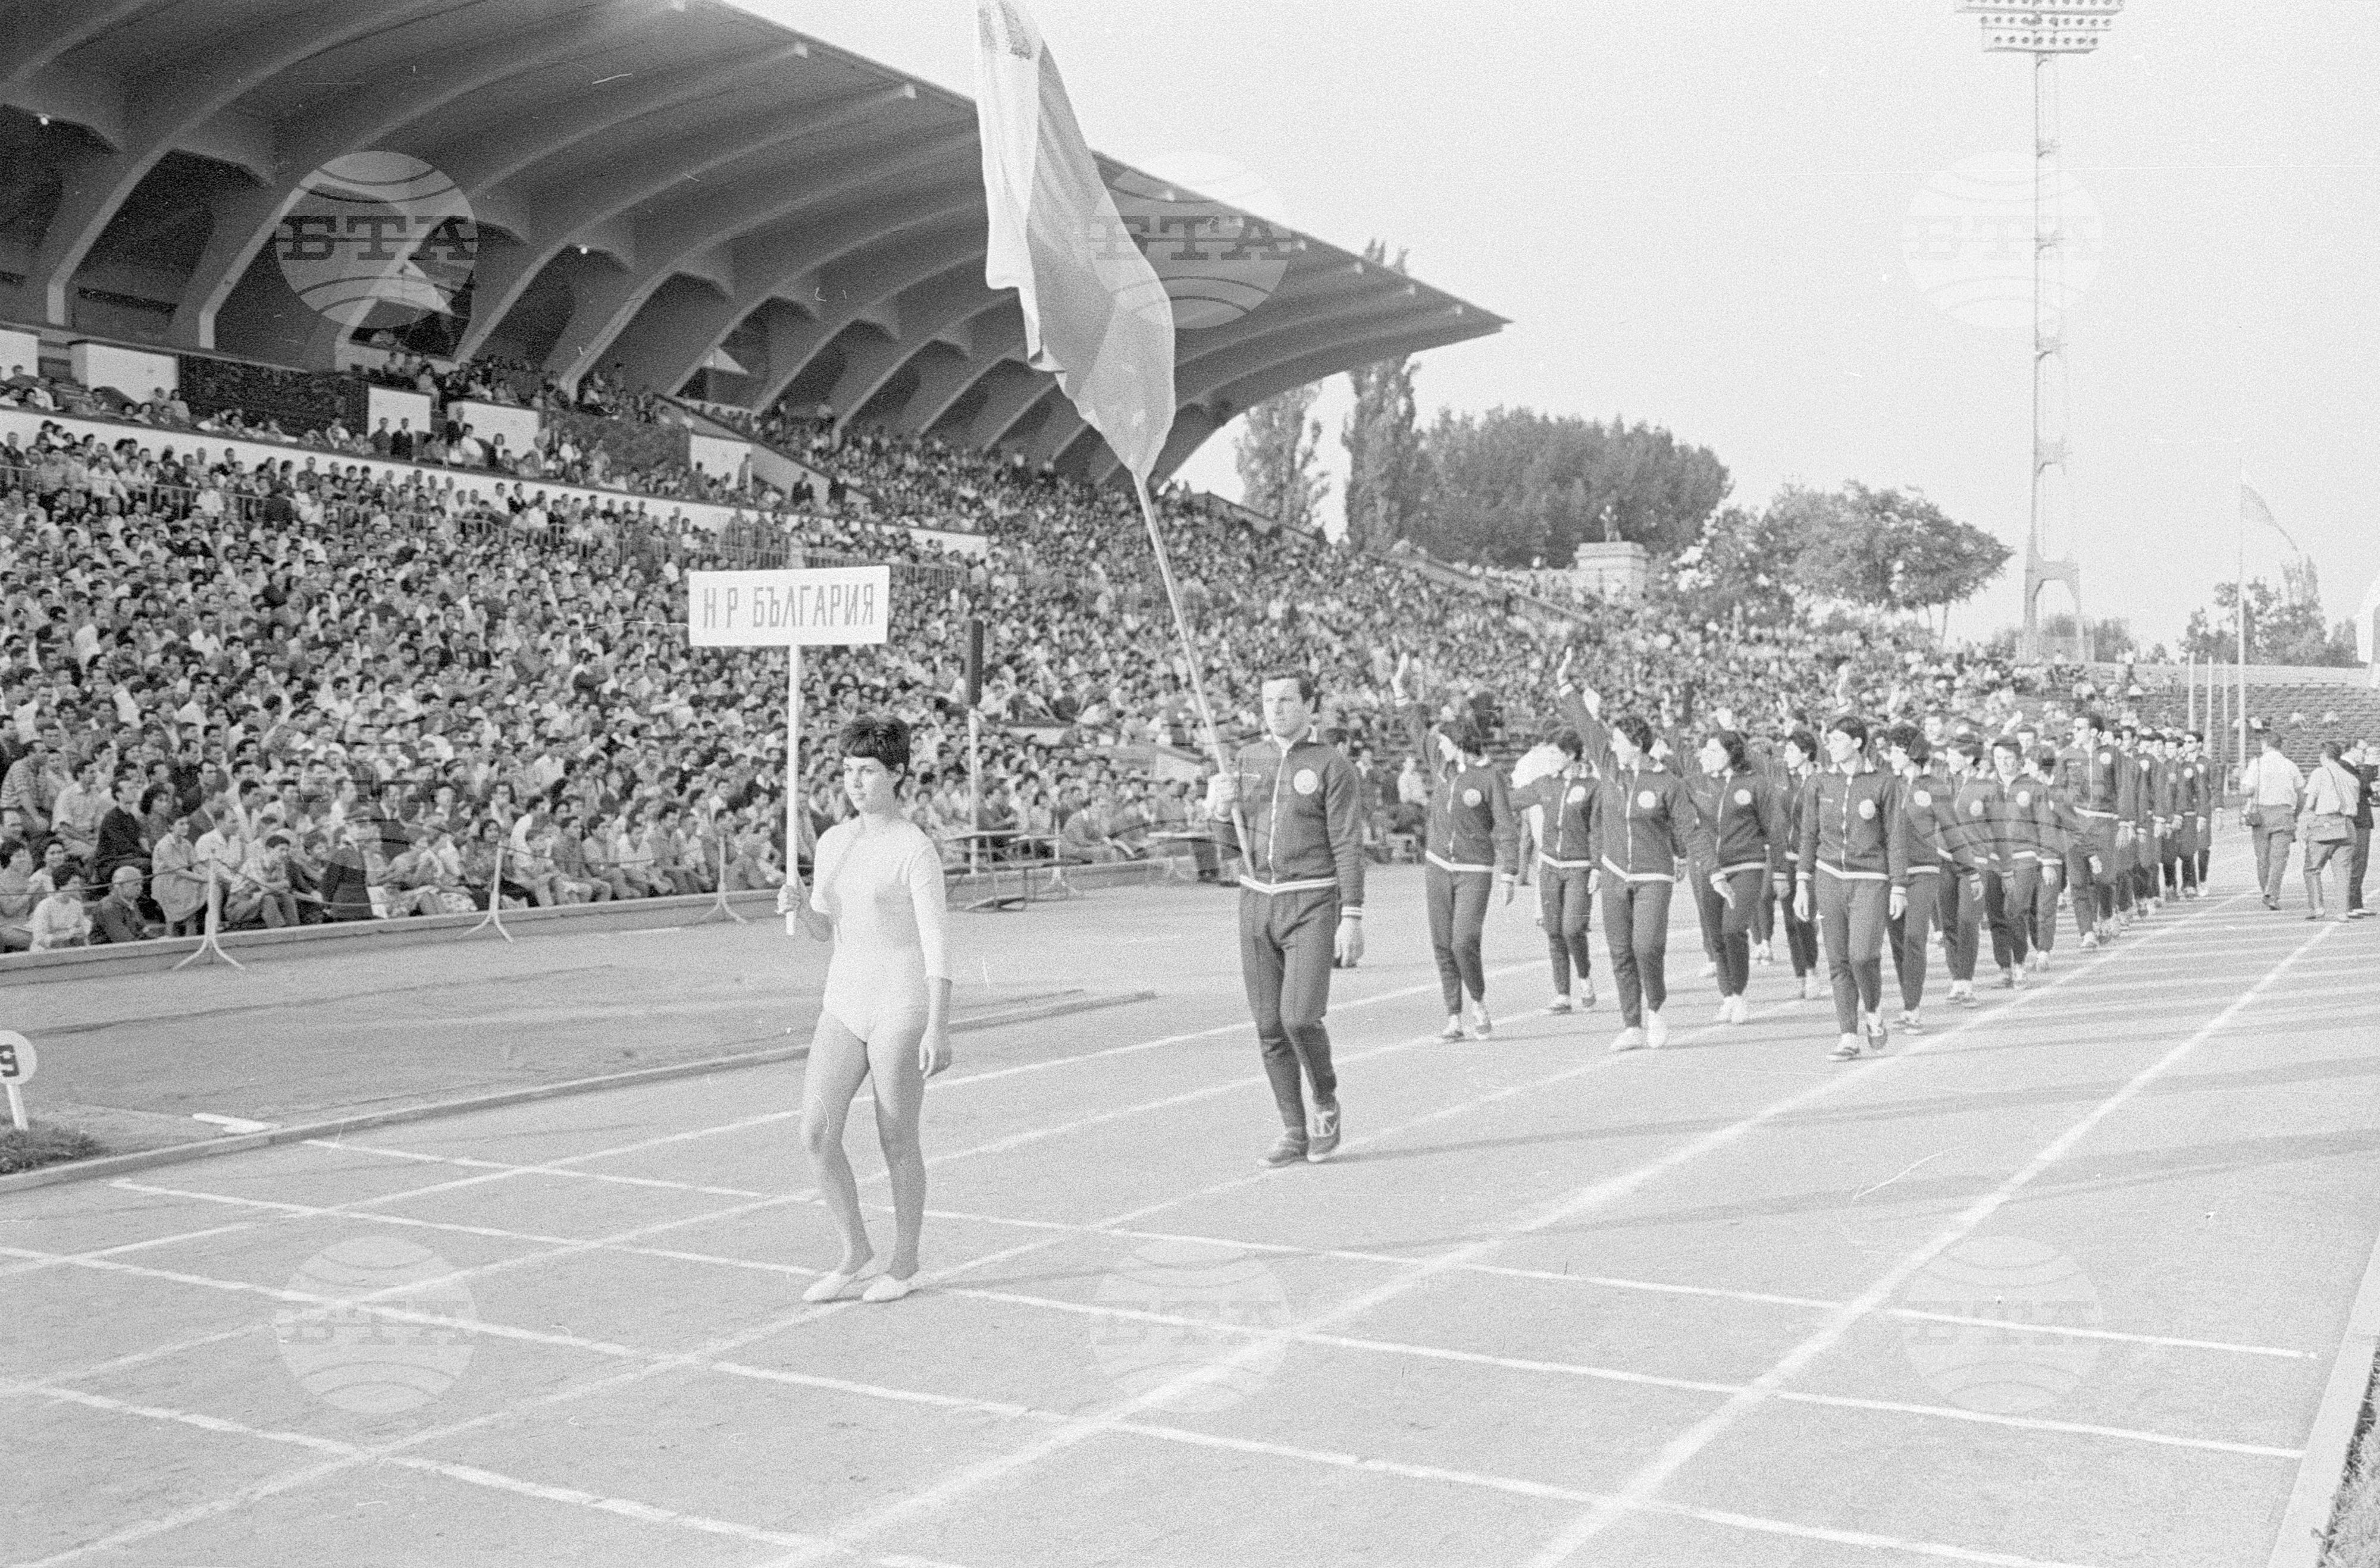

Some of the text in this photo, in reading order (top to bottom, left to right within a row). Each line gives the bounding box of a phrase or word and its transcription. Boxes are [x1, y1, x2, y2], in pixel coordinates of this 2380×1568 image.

[703, 583, 874, 628] Н Р БЪЛГАРИЯ
